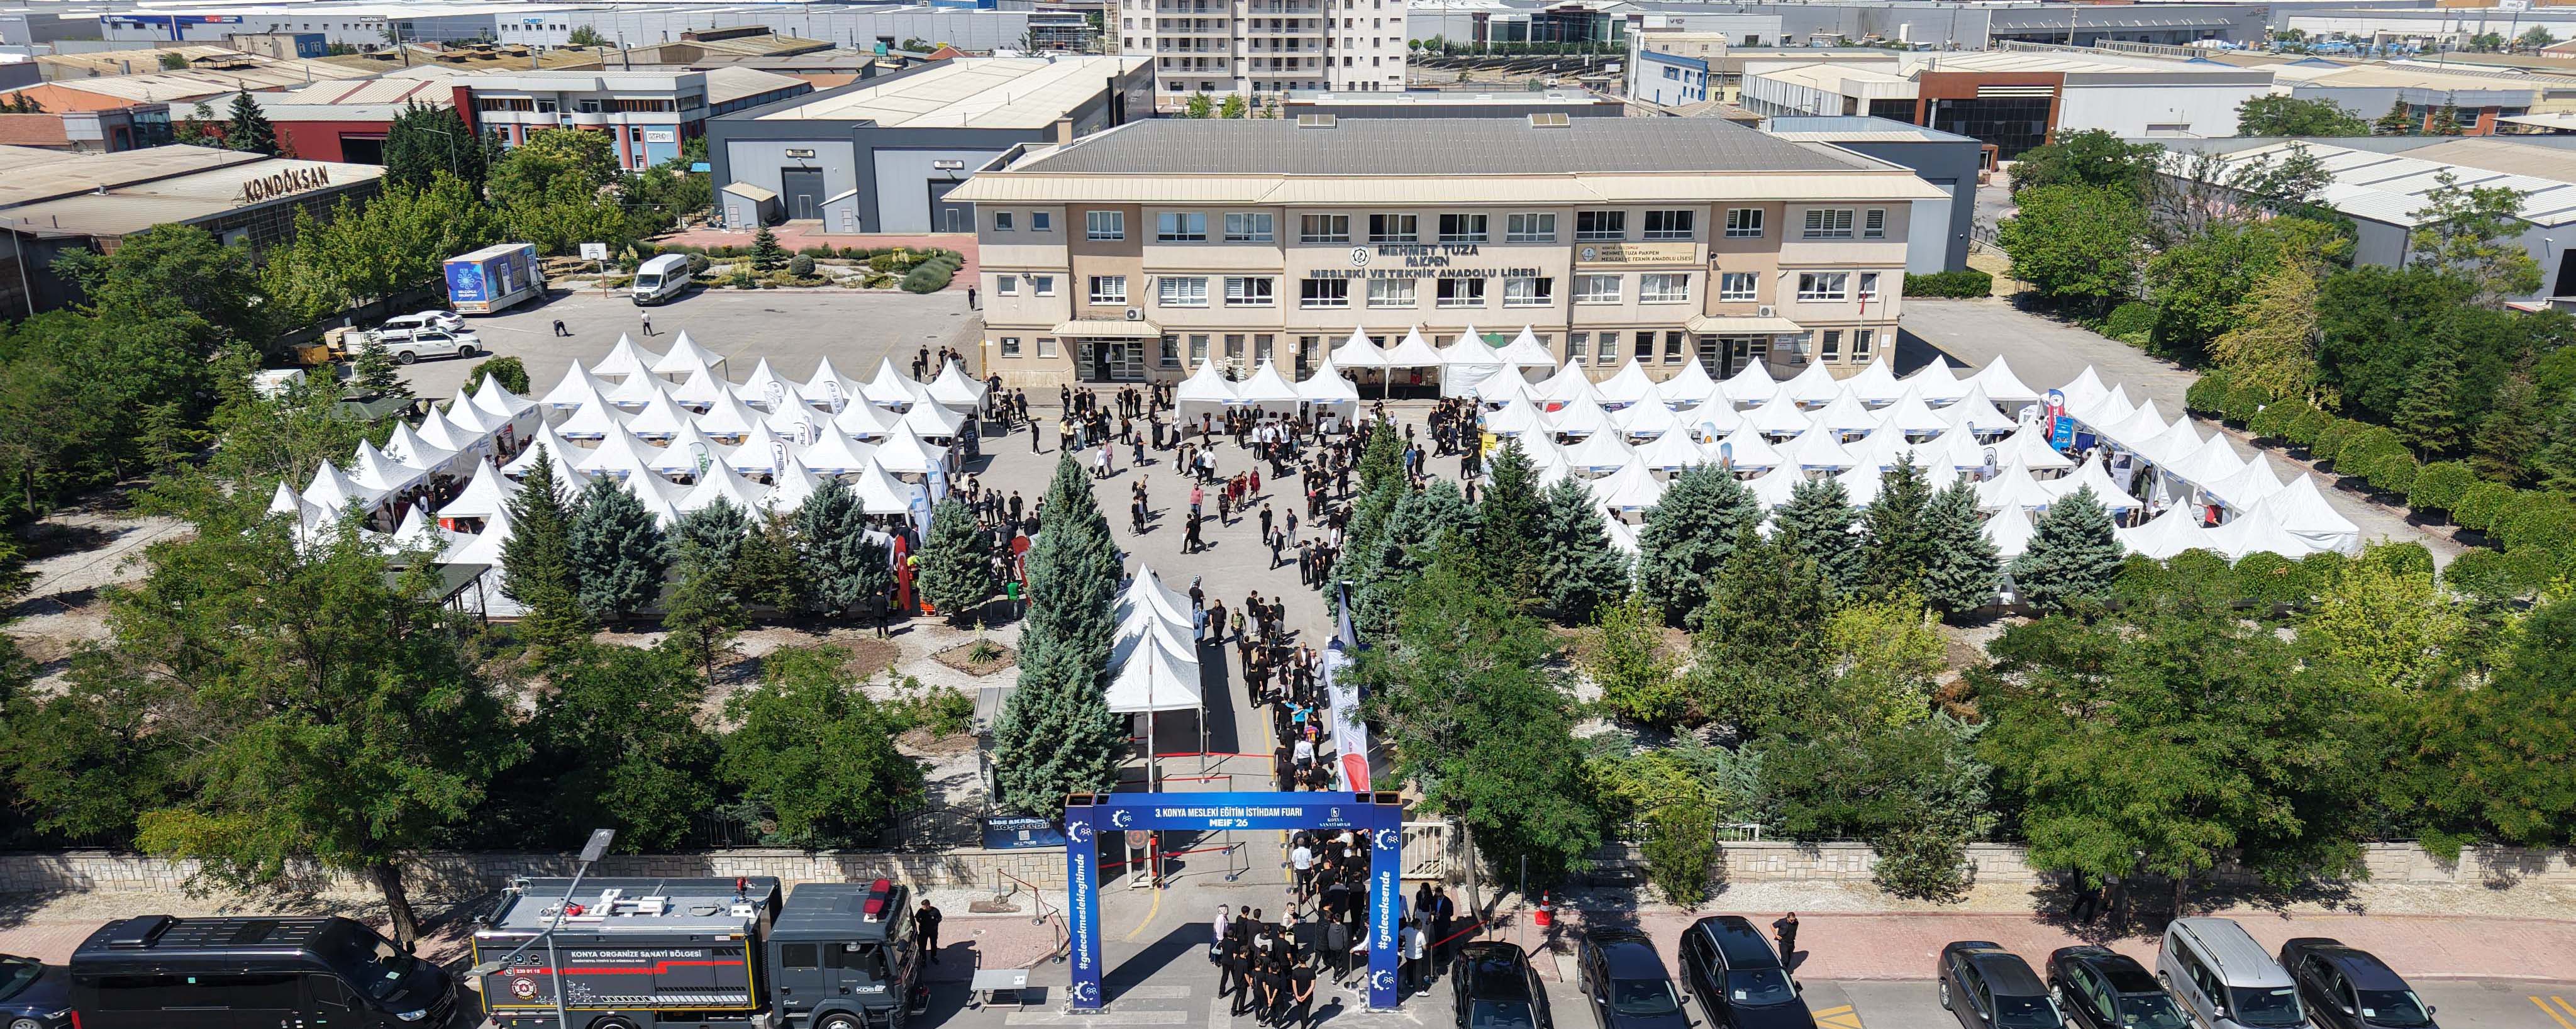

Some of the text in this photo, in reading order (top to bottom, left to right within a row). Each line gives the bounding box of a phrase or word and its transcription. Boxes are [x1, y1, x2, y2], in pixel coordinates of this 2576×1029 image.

[243, 165, 330, 203] KONDÖKSAN
[1378, 244, 1479, 257] MEHMET TUZA
[1406, 256, 1450, 267] PAKPEN
[1310, 265, 1541, 279] MESLEKİ VE TEKNİK ANADOLU LİSESİ
[1155, 806, 1302, 817] 3. KONYA MESLEKİ EĞİTİM İSTİHDAM FUARI
[1378, 870, 1391, 950] #geleceksende
